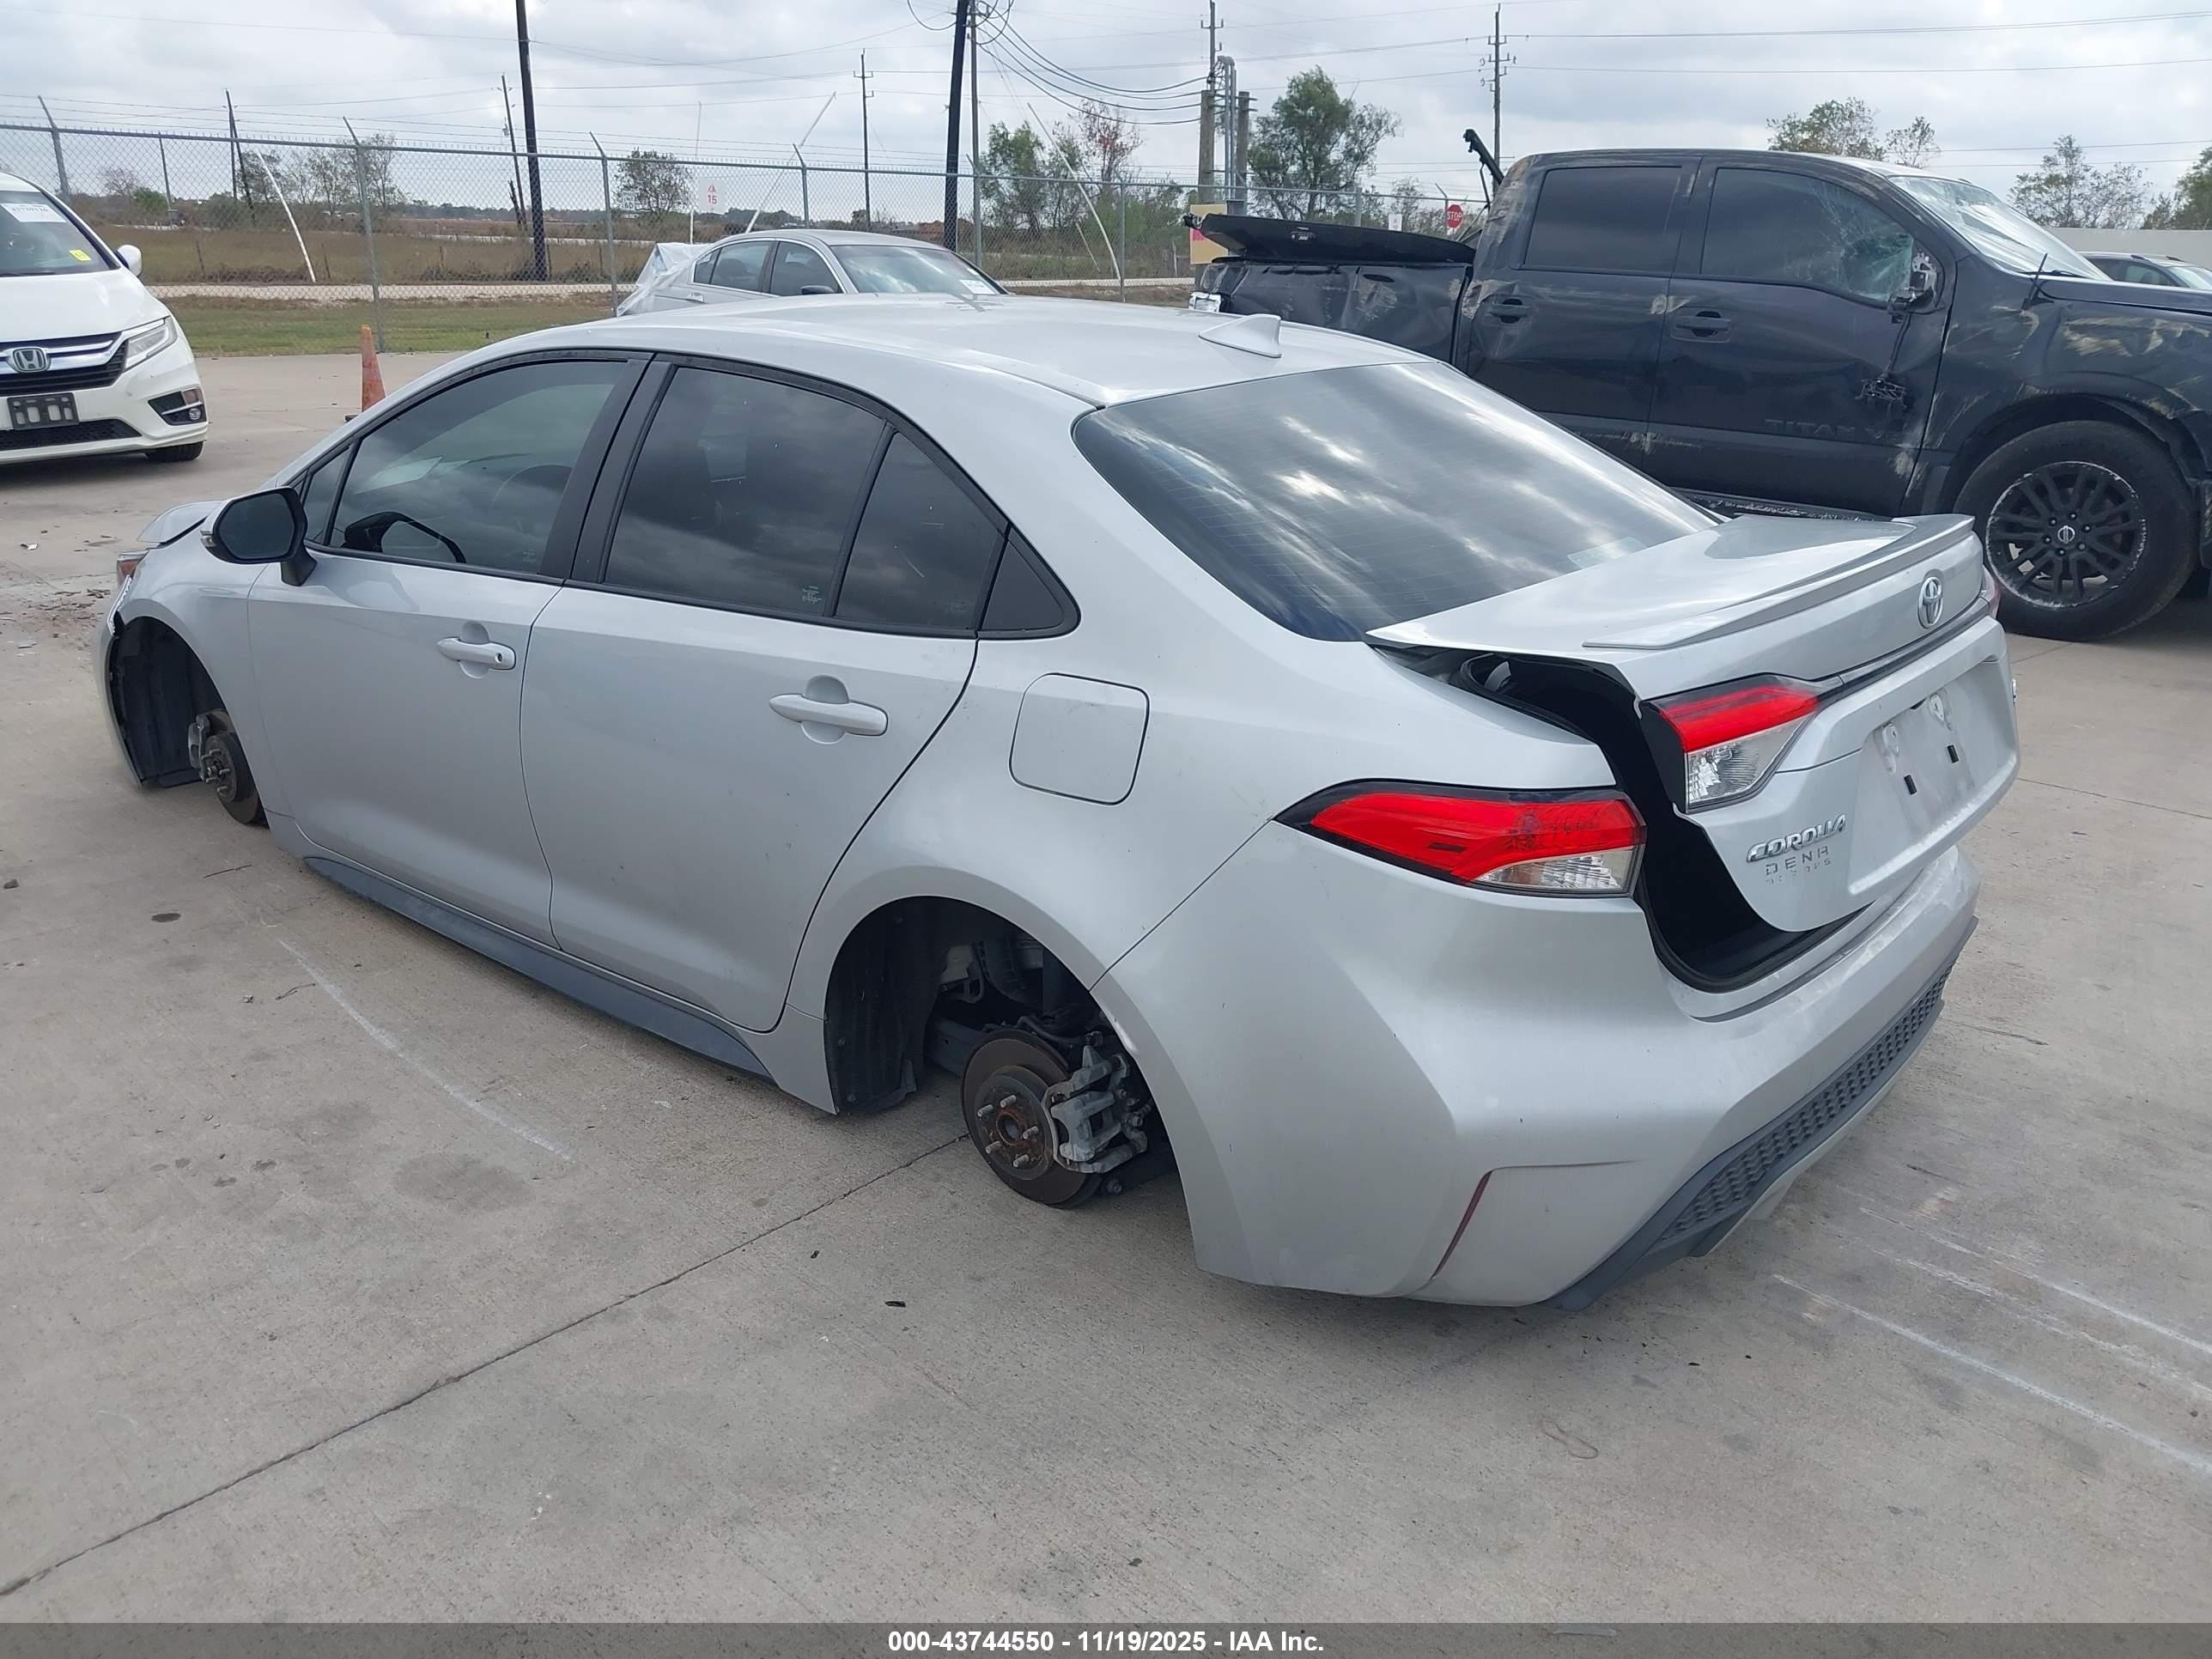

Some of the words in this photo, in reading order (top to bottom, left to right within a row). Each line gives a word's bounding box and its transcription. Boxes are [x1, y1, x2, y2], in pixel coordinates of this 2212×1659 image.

[708, 194, 718, 204] 15
[1447, 210, 1462, 221] STOP
[1765, 418, 1856, 439] TITAN
[1746, 813, 1846, 863] COROLLA
